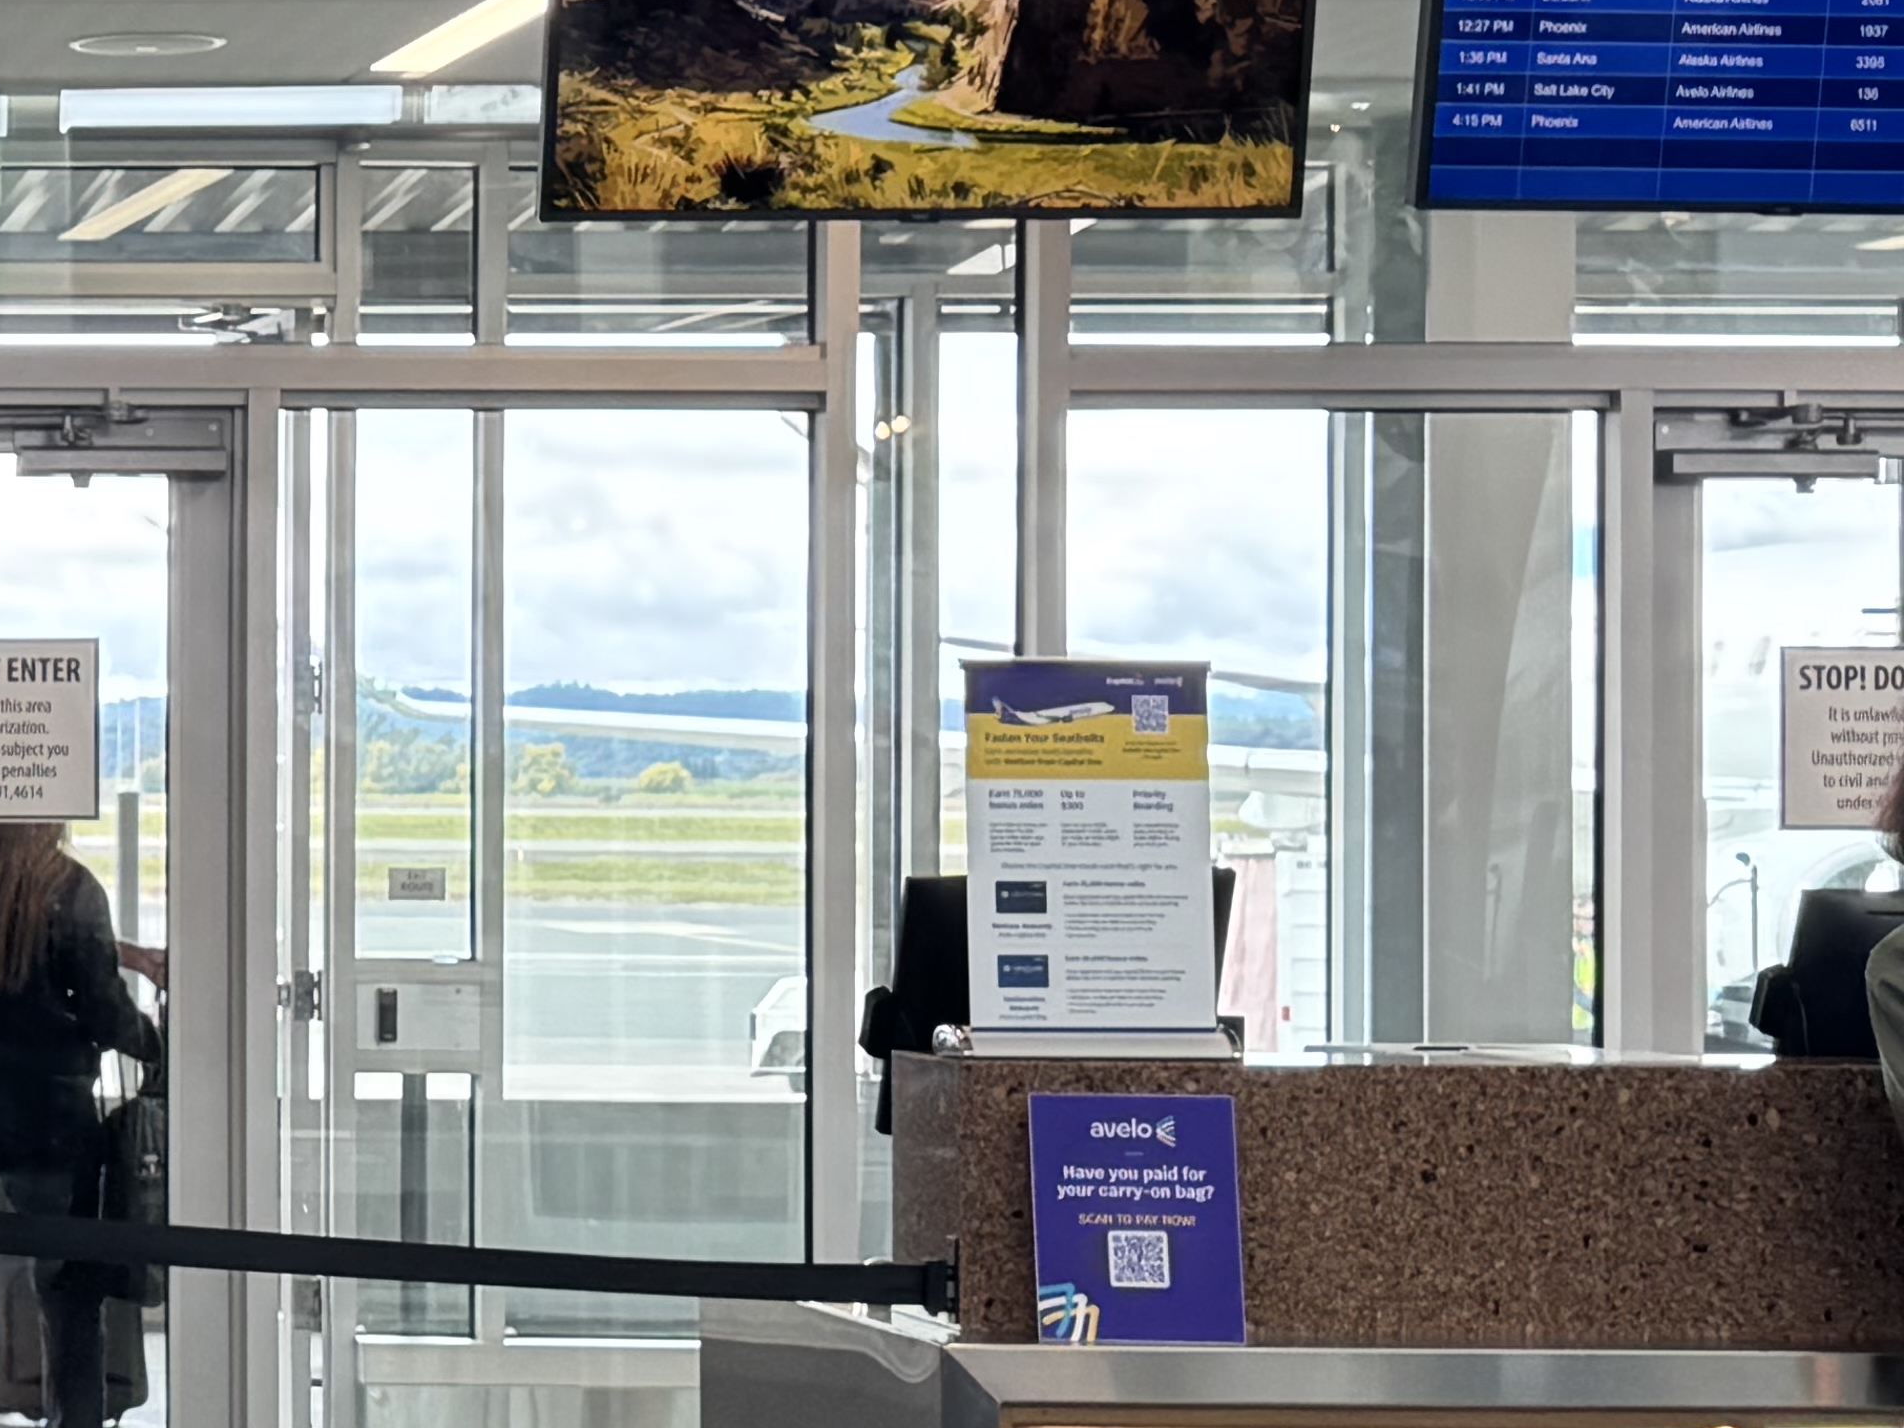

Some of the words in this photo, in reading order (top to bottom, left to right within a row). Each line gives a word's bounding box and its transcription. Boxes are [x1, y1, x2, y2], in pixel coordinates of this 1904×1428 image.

[1493, 20, 1514, 32] PM
[1539, 20, 1587, 33] Phoenix
[1681, 22, 1737, 36] American
[1738, 23, 1782, 36] Airlines
[1486, 51, 1507, 63] PM
[1537, 52, 1570, 65] Santa
[1572, 53, 1597, 65] Ana
[1678, 54, 1717, 67] Alaska
[1720, 55, 1763, 68] Airlines
[1456, 83, 1480, 95] 1:41
[1484, 83, 1504, 95] PM
[1534, 83, 1557, 97] Salt
[1559, 84, 1588, 97] Lake
[1591, 84, 1615, 100] City
[1710, 85, 1754, 99] Airlines
[1481, 114, 1503, 127] PM
[1531, 115, 1579, 128] Phoenix
[1673, 117, 1728, 130] American
[1730, 117, 1773, 130] Airlines
[7, 657, 81, 683] ENTER
[1798, 665, 1866, 691] STOP!
[1874, 665, 1904, 691] DO
[0, 698, 23, 714] this
[25, 701, 52, 714] area
[1828, 706, 1838, 721] It
[1841, 707, 1850, 721] is
[1830, 728, 1879, 744] without
[1, 742, 44, 760] subject
[47, 744, 69, 759] you
[1, 763, 57, 781] penalties
[1823, 774, 1836, 788] to
[1839, 773, 1863, 788] civil
[1090, 1117, 1153, 1139] avelo
[1063, 1165, 1105, 1180] Have
[1108, 1167, 1139, 1183] you
[1143, 1164, 1178, 1183] paid
[1182, 1165, 1207, 1182] for
[1057, 1183, 1095, 1200] your
[1098, 1184, 1171, 1201] carry-on
[1175, 1184, 1215, 1203] bag?
[1078, 1213, 1113, 1225] SCAN
[1117, 1213, 1132, 1225] TO
[1135, 1213, 1159, 1226] PAY
